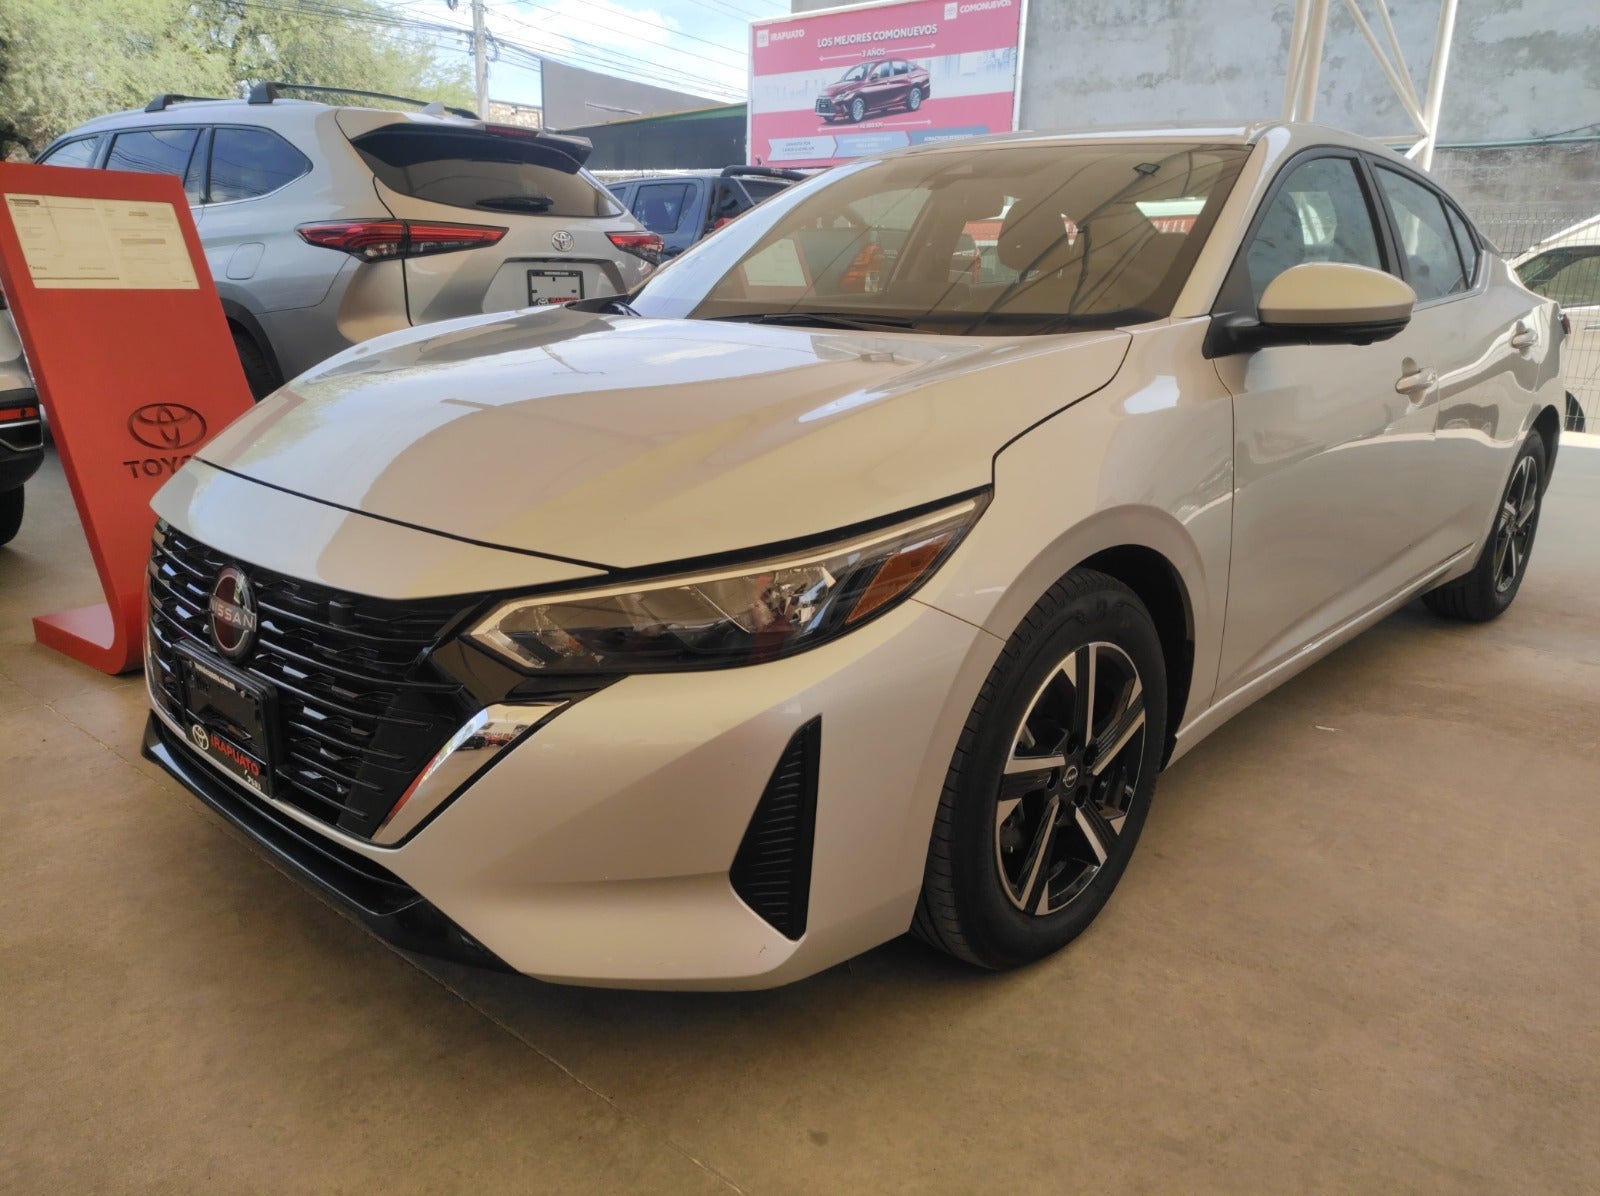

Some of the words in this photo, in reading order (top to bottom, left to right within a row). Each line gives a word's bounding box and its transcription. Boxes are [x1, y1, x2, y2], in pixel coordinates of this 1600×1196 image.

[959, 0, 1011, 13] COMONUEVOS
[770, 29, 805, 41] IRAPUATO
[817, 36, 833, 48] LOS
[833, 31, 872, 46] MEJORES
[872, 23, 938, 41] COMONUEVOS
[867, 46, 886, 57] AÑOS
[211, 597, 254, 629] NISSAN
[210, 733, 261, 777] IRAPUATO
